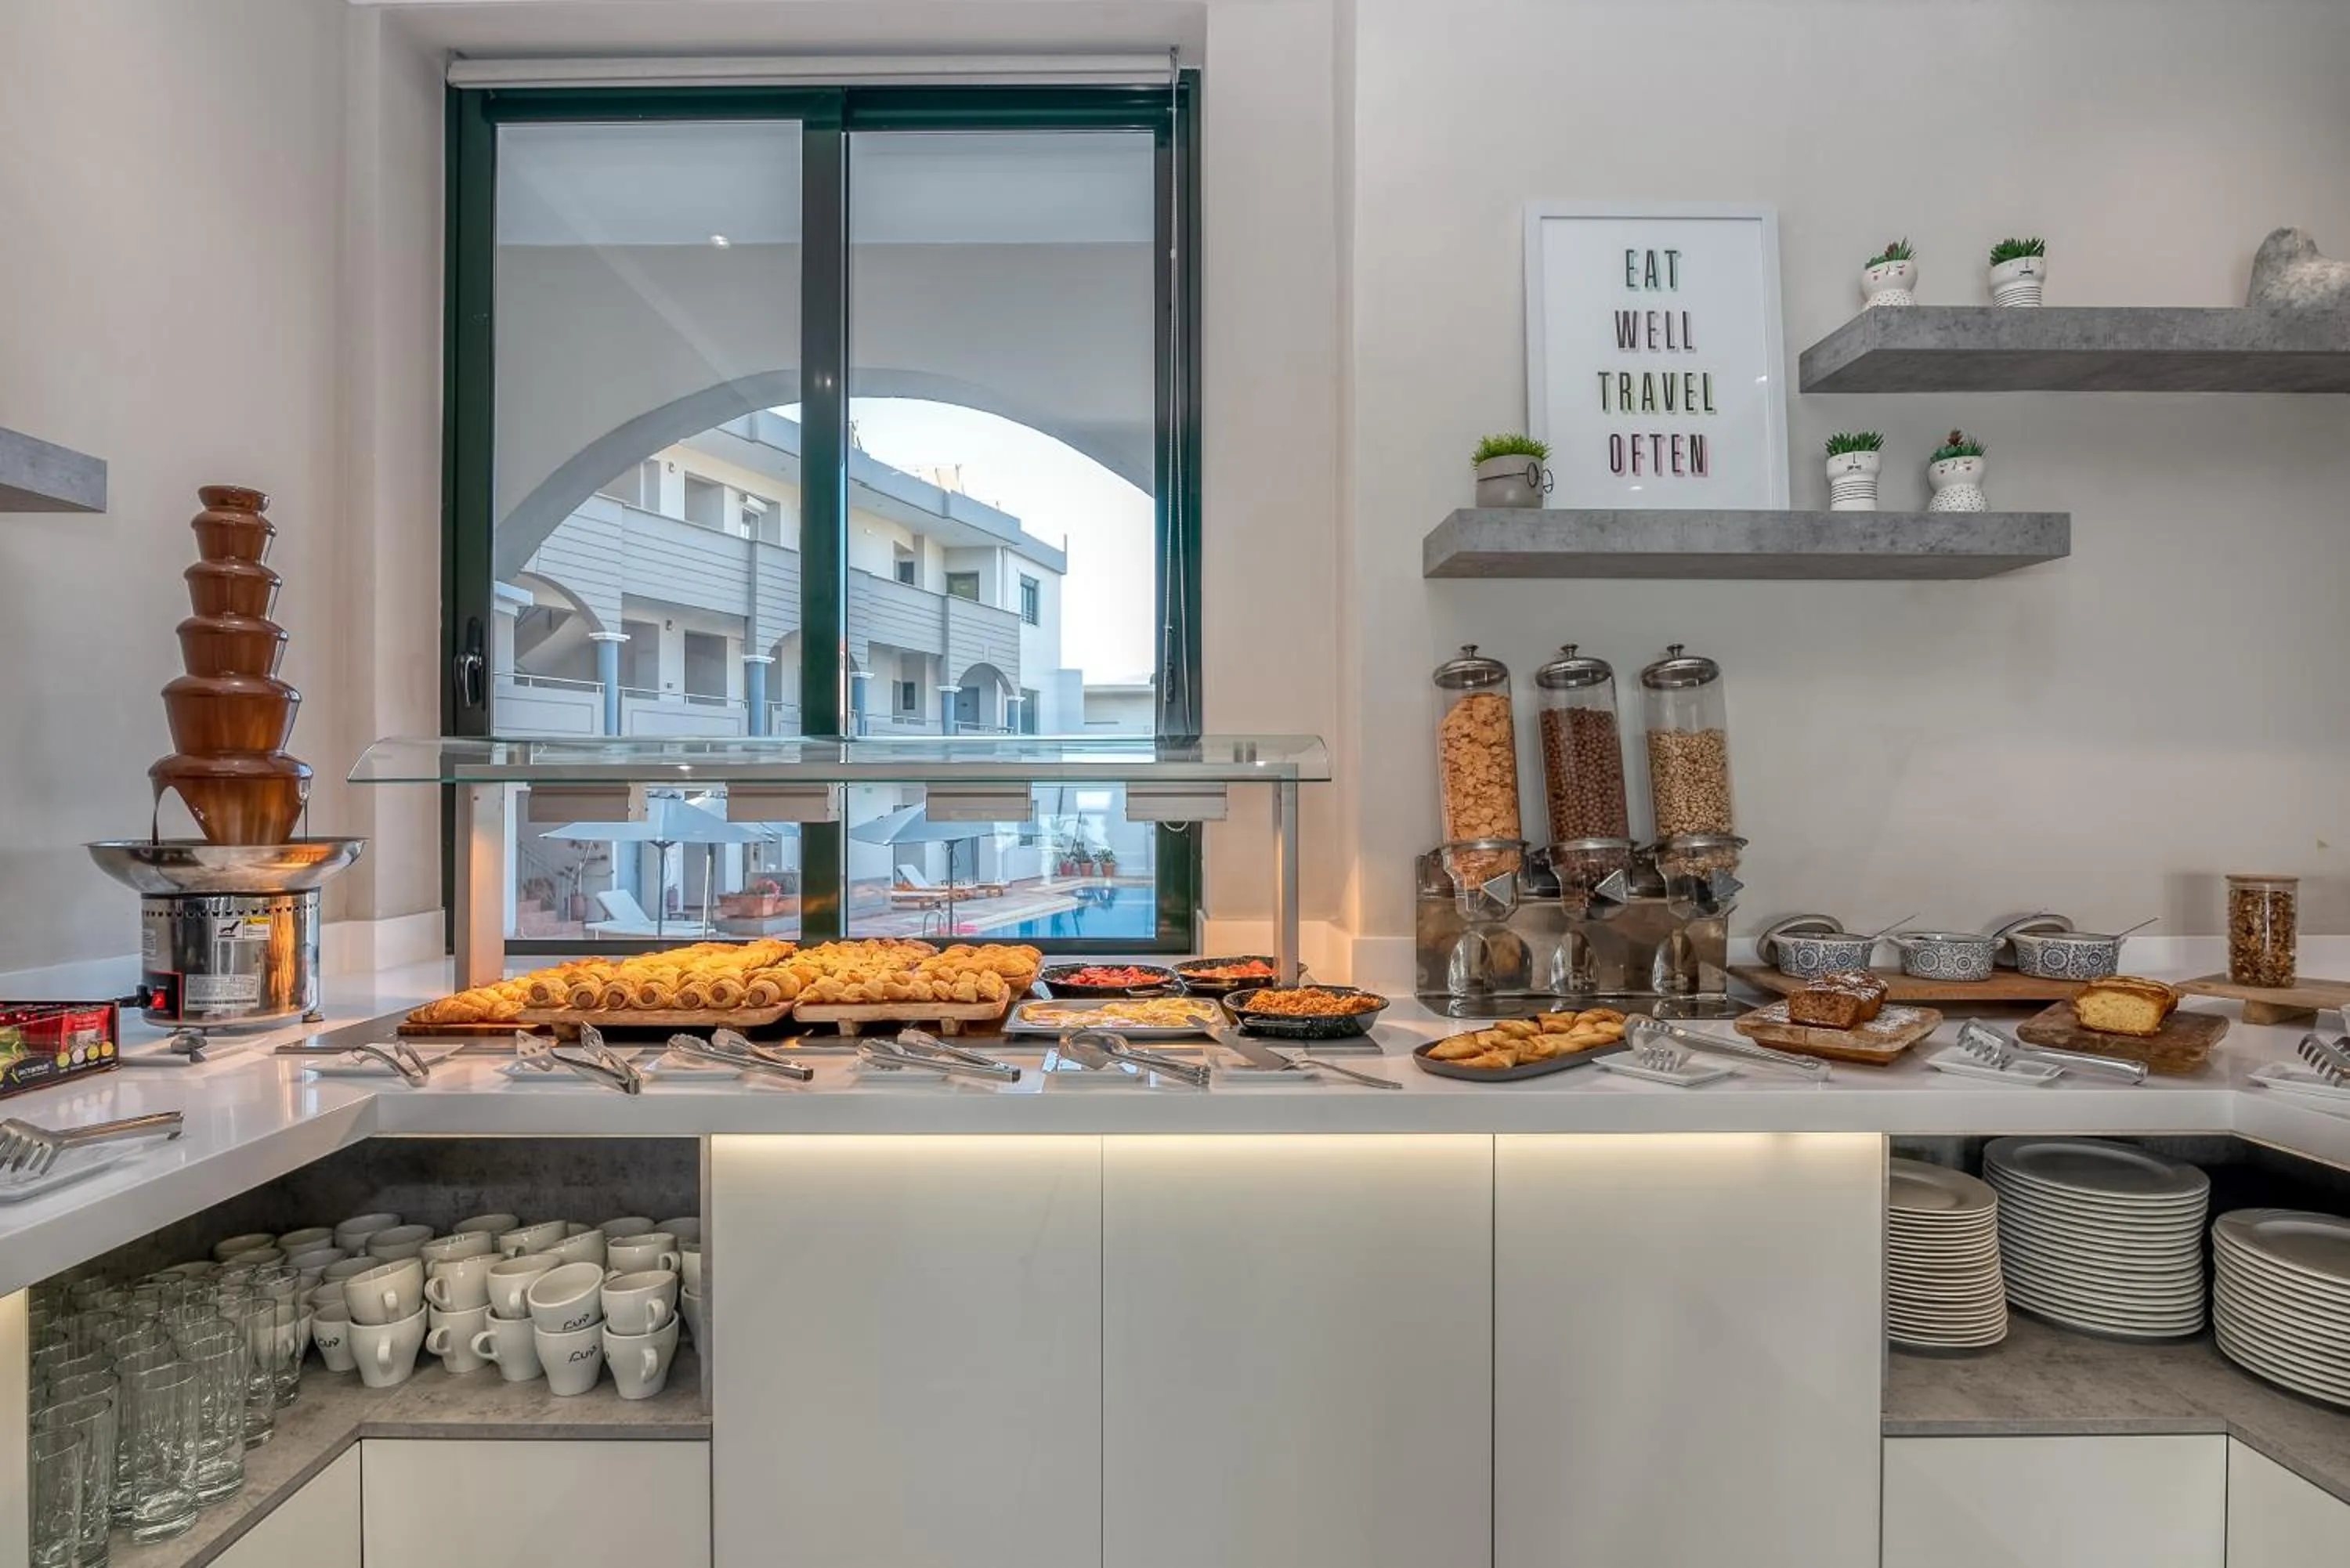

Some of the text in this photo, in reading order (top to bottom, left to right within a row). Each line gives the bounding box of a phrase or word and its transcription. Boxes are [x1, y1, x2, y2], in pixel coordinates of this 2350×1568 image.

[1625, 249, 1680, 291] EAT
[1614, 310, 1697, 352] WELL
[1597, 371, 1717, 414] TRAVEL
[1609, 433, 1708, 476] OFTEN
